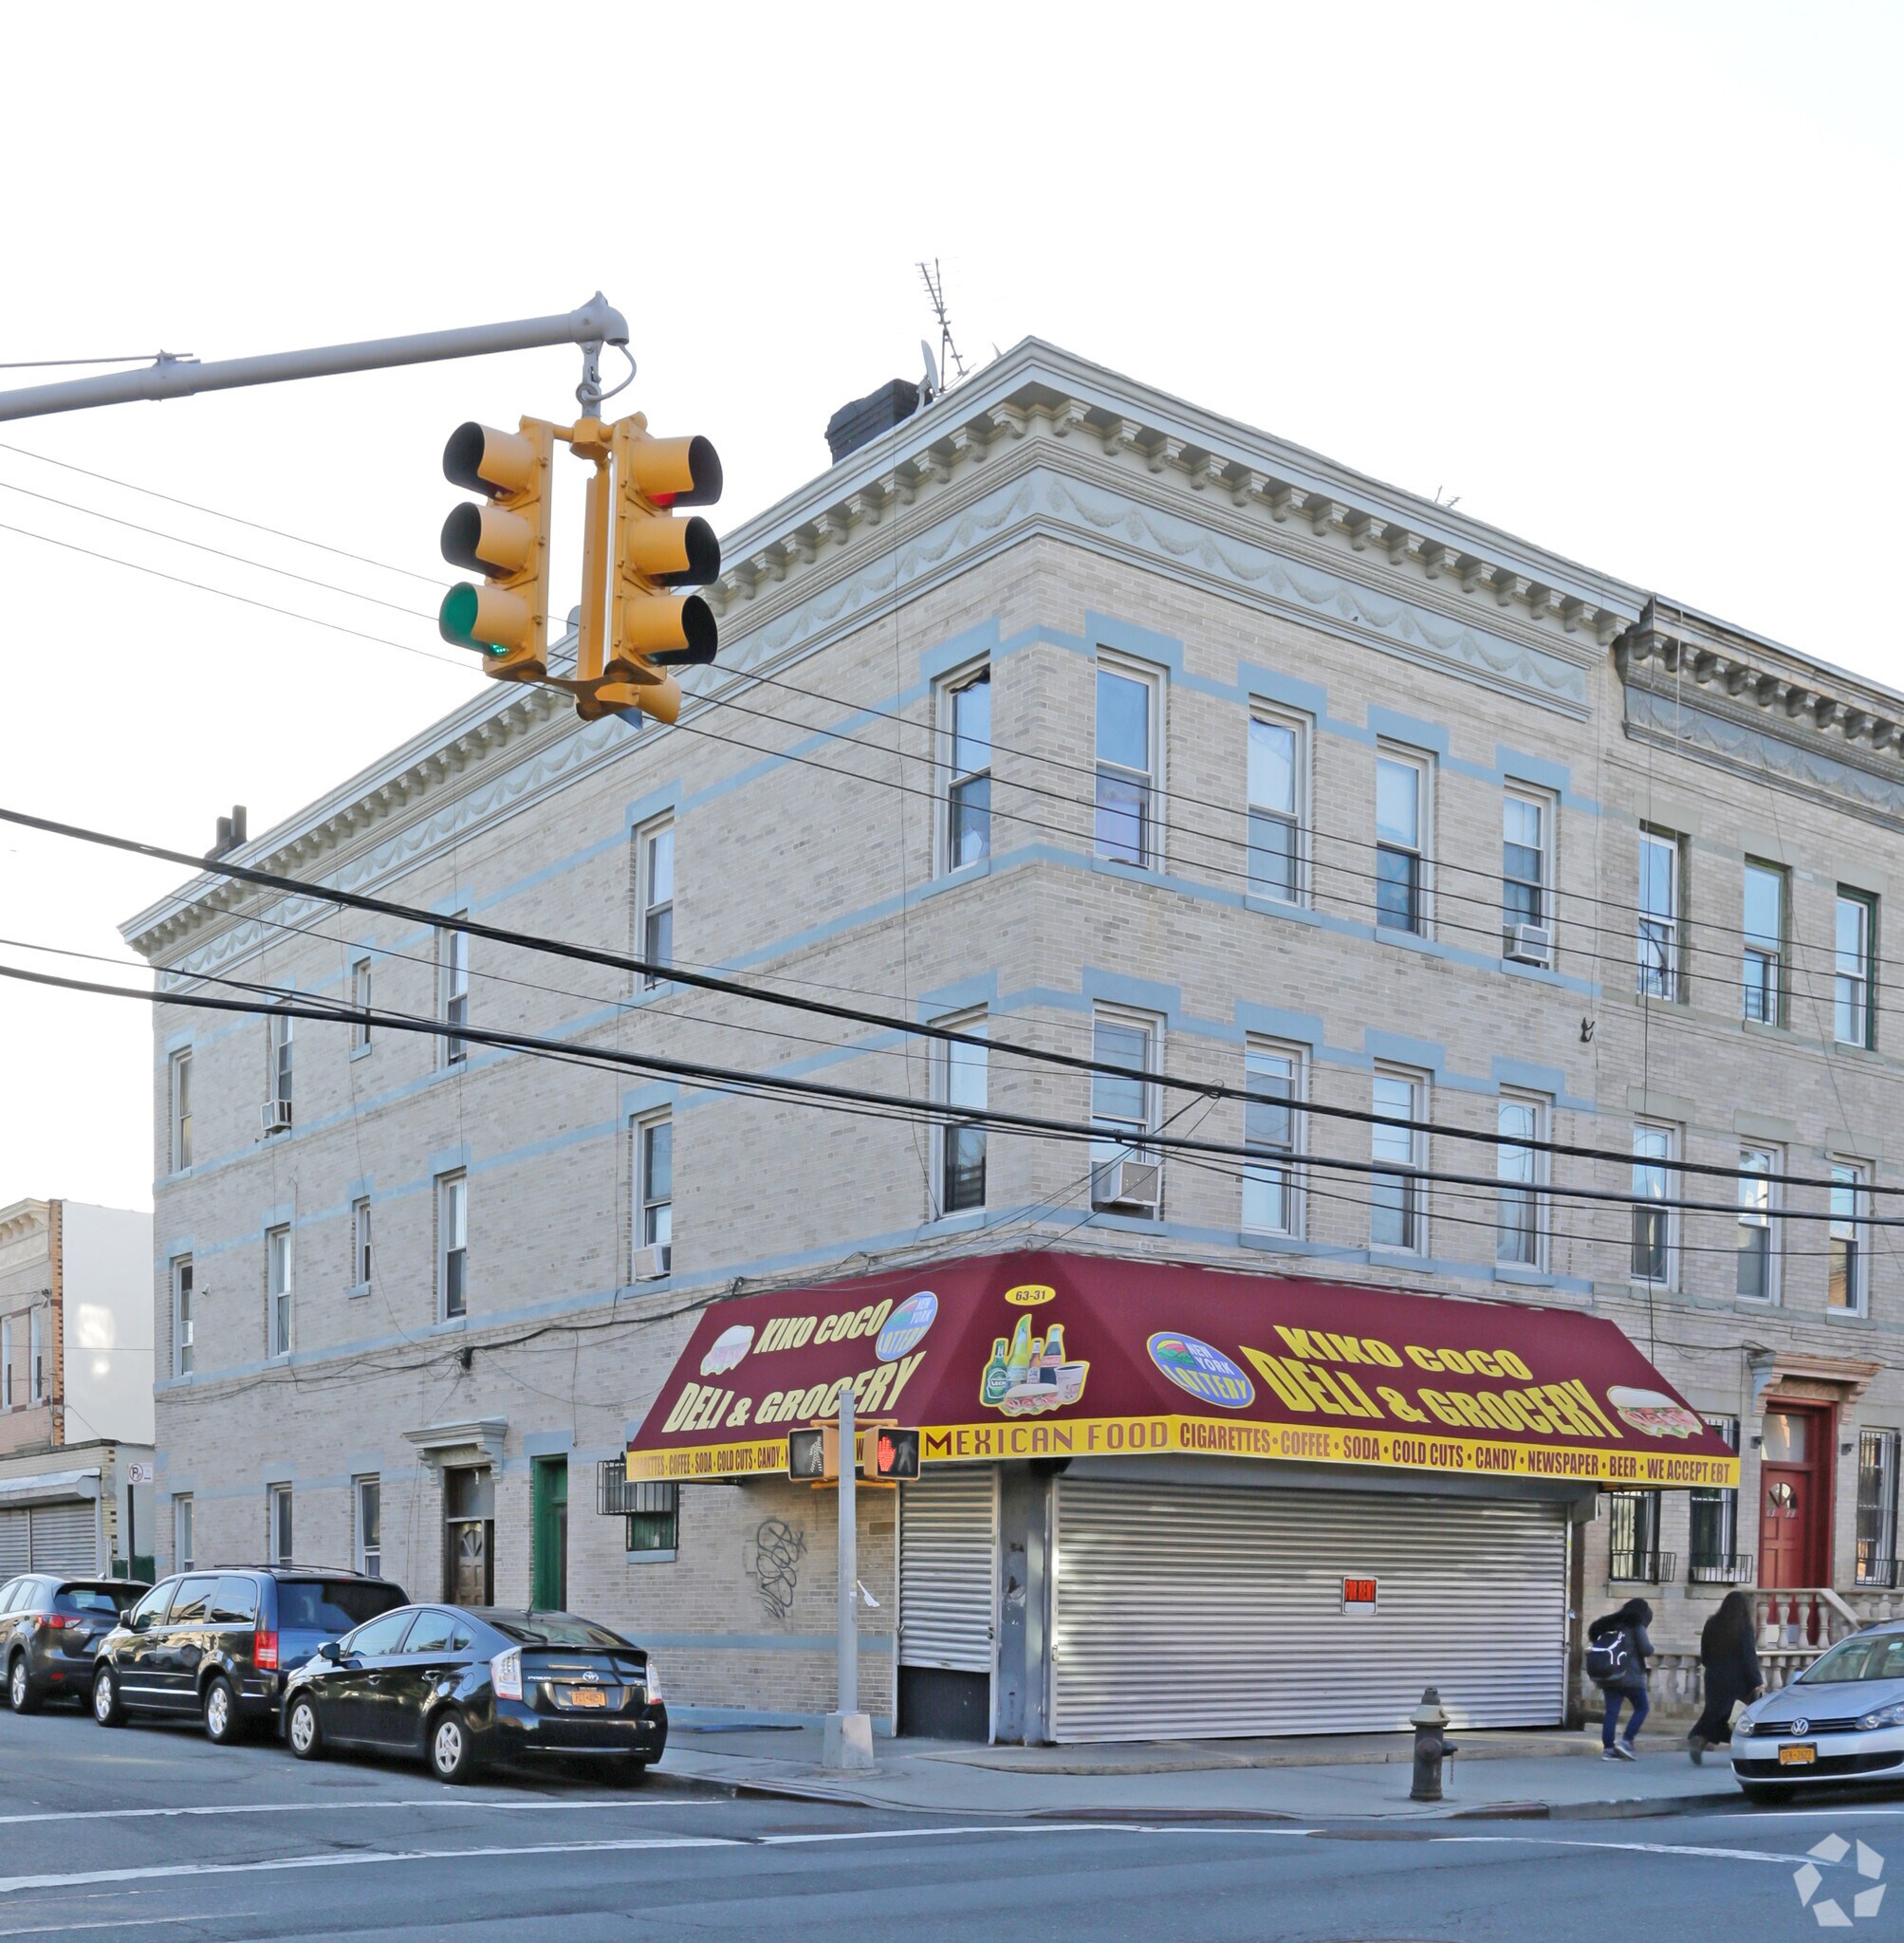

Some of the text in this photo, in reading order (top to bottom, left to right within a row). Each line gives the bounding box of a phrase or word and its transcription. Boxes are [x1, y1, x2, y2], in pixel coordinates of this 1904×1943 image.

[1015, 1290, 1045, 1301] 63-31
[753, 1299, 893, 1354] KIKO COCO
[911, 1309, 933, 1324] YORK
[1185, 1342, 1213, 1359] NEW
[1194, 1356, 1235, 1375] YORK
[1273, 1324, 1533, 1380] KIKO COCO
[661, 1351, 927, 1433] DELI & GROCERY
[1162, 1364, 1247, 1399] LOTTERY
[1239, 1345, 1624, 1438] DELI & GROCERY
[926, 1421, 1168, 1456] MEXICAN FOOD
[1180, 1422, 1730, 1484] CIGARETTES COFFEE SODA COLD CUTS CANDY NEWSPAPER BEER WE ACCEPT EBT
[631, 1455, 664, 1477] GARETTES
[669, 1453, 691, 1475] COFFEE
[694, 1452, 712, 1473] SODA
[717, 1449, 733, 1471] COLD
[735, 1447, 752, 1470] CUTS
[757, 1445, 780, 1469] CANDY
